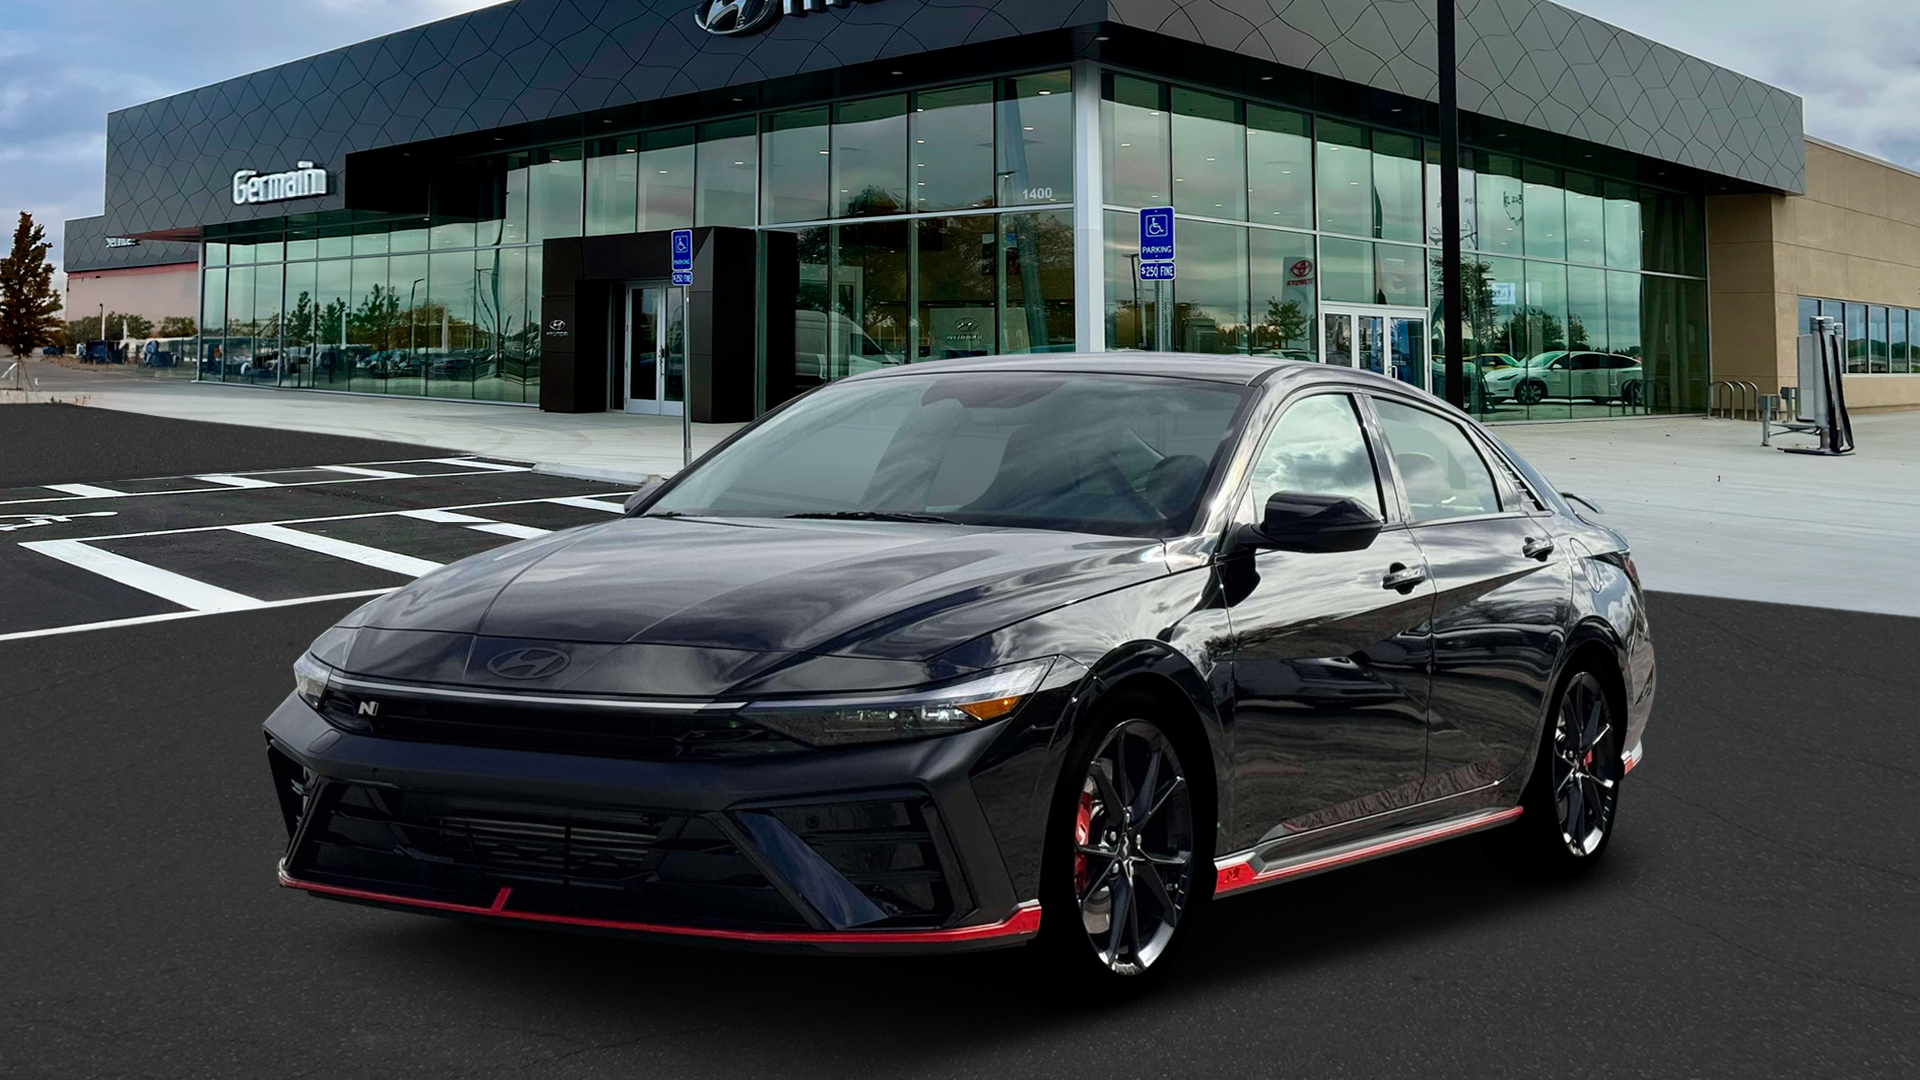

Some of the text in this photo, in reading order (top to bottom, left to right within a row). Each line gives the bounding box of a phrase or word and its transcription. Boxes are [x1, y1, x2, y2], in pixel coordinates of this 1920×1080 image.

[232, 160, 328, 206] Germain
[1022, 187, 1053, 200] 1400
[1141, 245, 1172, 254] PARKING
[1141, 265, 1174, 278] $250 FINE
